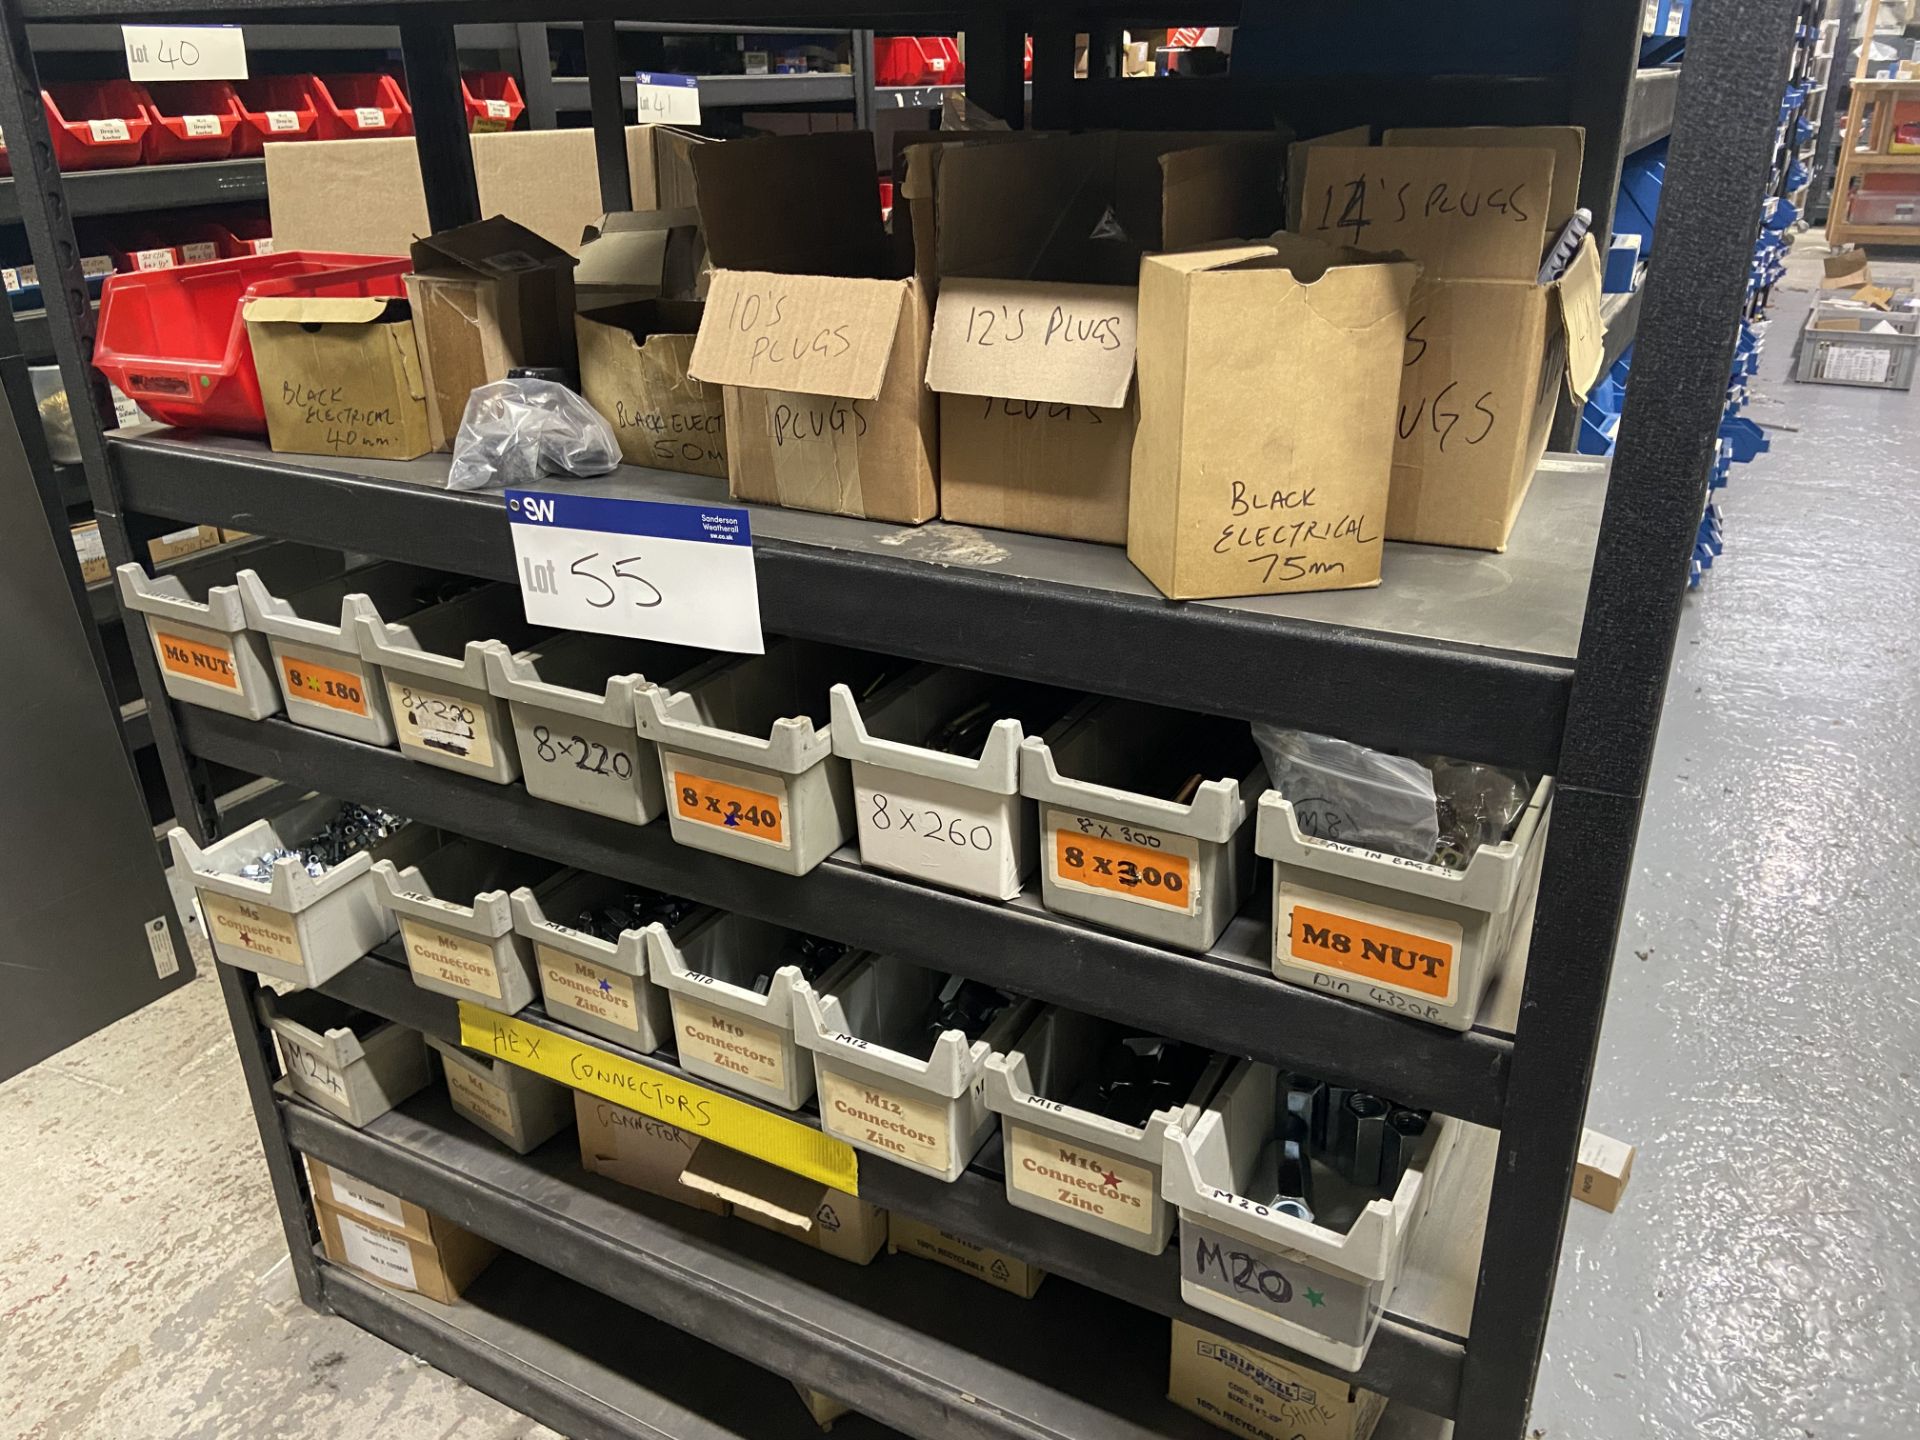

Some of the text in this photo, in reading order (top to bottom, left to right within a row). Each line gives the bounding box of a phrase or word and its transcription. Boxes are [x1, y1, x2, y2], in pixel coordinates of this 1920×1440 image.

[129, 40, 199, 70] Lot 40
[1044, 305, 1121, 350] PLUGS
[283, 380, 342, 407] BLACK
[616, 400, 668, 433] BLACK
[524, 497, 555, 523] SW
[1231, 481, 1316, 516] BLACK
[701, 513, 738, 525] Sanderson
[702, 523, 739, 533] Weatherall
[710, 533, 733, 541] sw.co.uk
[1214, 515, 1377, 553] ELECTRICAL
[523, 552, 662, 608] Lot 55
[164, 644, 229, 675] M6 NUT
[289, 669, 302, 687] 8
[325, 680, 360, 703] 180
[682, 787, 699, 807] 8
[1065, 846, 1084, 868] 8
[1365, 850, 1382, 860] IN
[217, 915, 292, 944] Connectors
[437, 935, 458, 951] M6
[414, 944, 491, 977] Connectors
[1302, 923, 1445, 978] M8 NUT
[440, 967, 471, 986] Zinc
[549, 970, 629, 1008] Connectors
[575, 995, 607, 1016] Zinc
[711, 1016, 744, 1037] M10
[685, 1025, 775, 1067] Connectors
[835, 1033, 868, 1050] M12
[287, 1041, 342, 1094] M24
[493, 1022, 710, 1126] HEX CONNECTORS
[713, 1051, 749, 1075] Zinc
[865, 1091, 902, 1116] M12
[1027, 1096, 1063, 1112] M16
[834, 1100, 936, 1146] Connectors
[866, 1128, 906, 1153] Zinc
[1059, 1148, 1102, 1174] M16
[1022, 1158, 1141, 1208] Connectors
[1058, 1188, 1104, 1215] Zinc
[1196, 1236, 1293, 1304] M20
[1218, 1347, 1295, 1399] GRIPWELL
